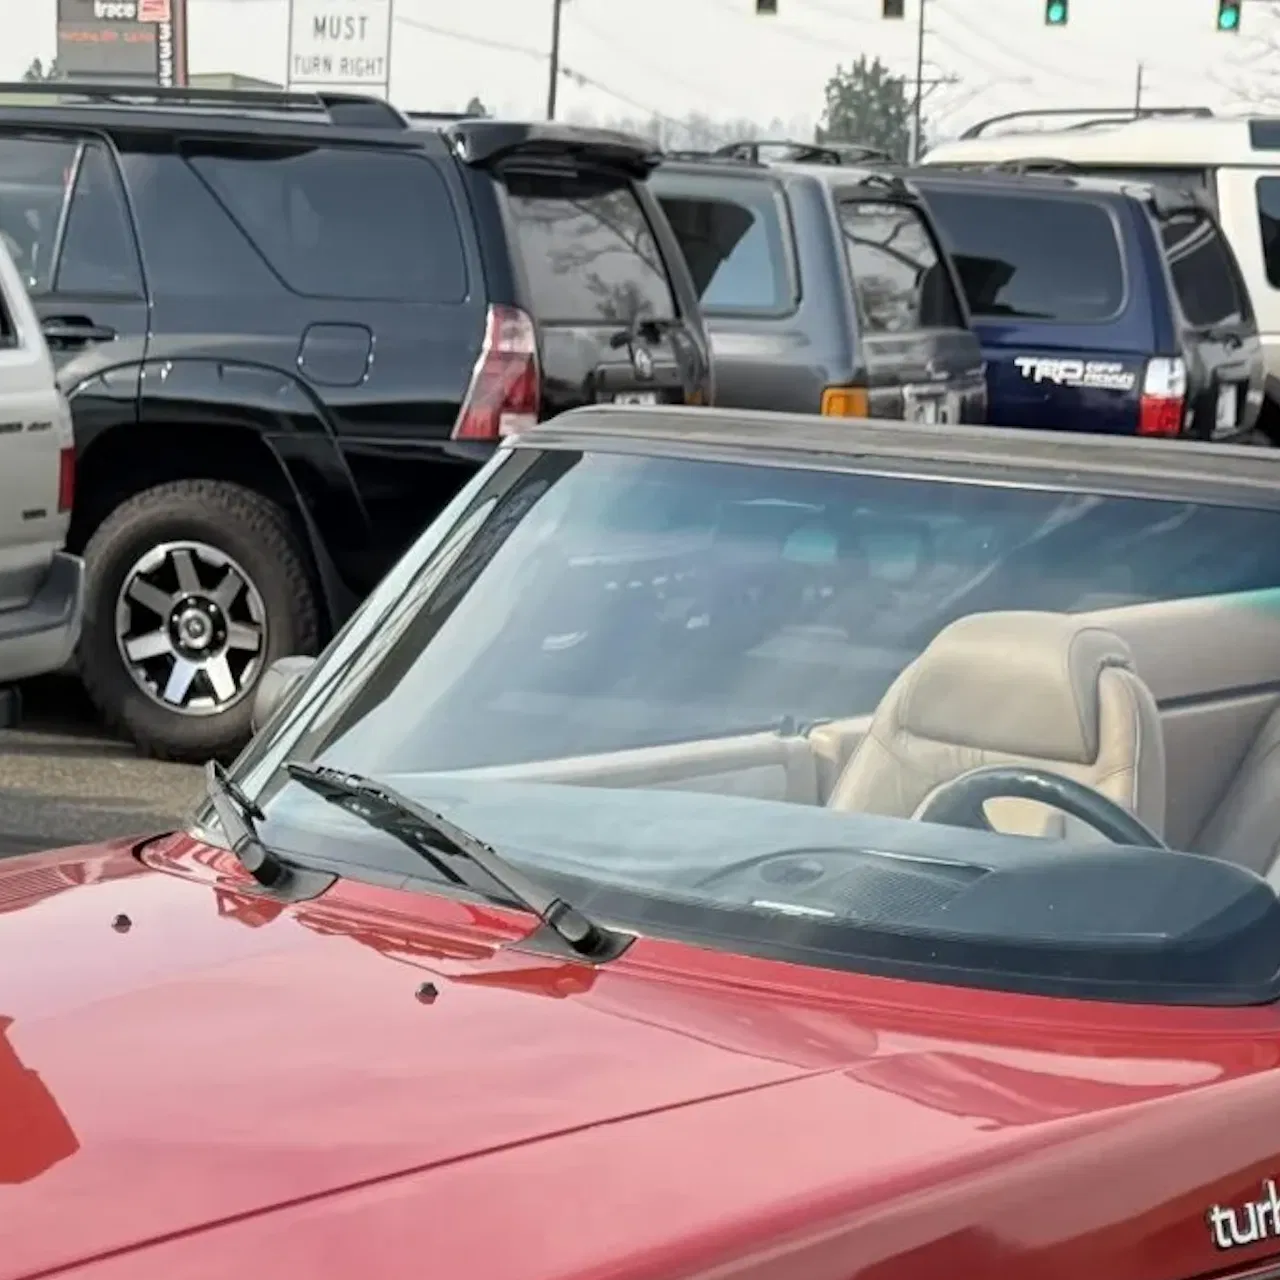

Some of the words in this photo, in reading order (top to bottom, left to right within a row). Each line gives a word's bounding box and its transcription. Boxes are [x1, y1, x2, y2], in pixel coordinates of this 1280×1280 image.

[313, 15, 368, 40] MUST
[294, 54, 332, 76] TURN
[340, 56, 384, 77] RIGHT
[1014, 356, 1084, 385] TRD
